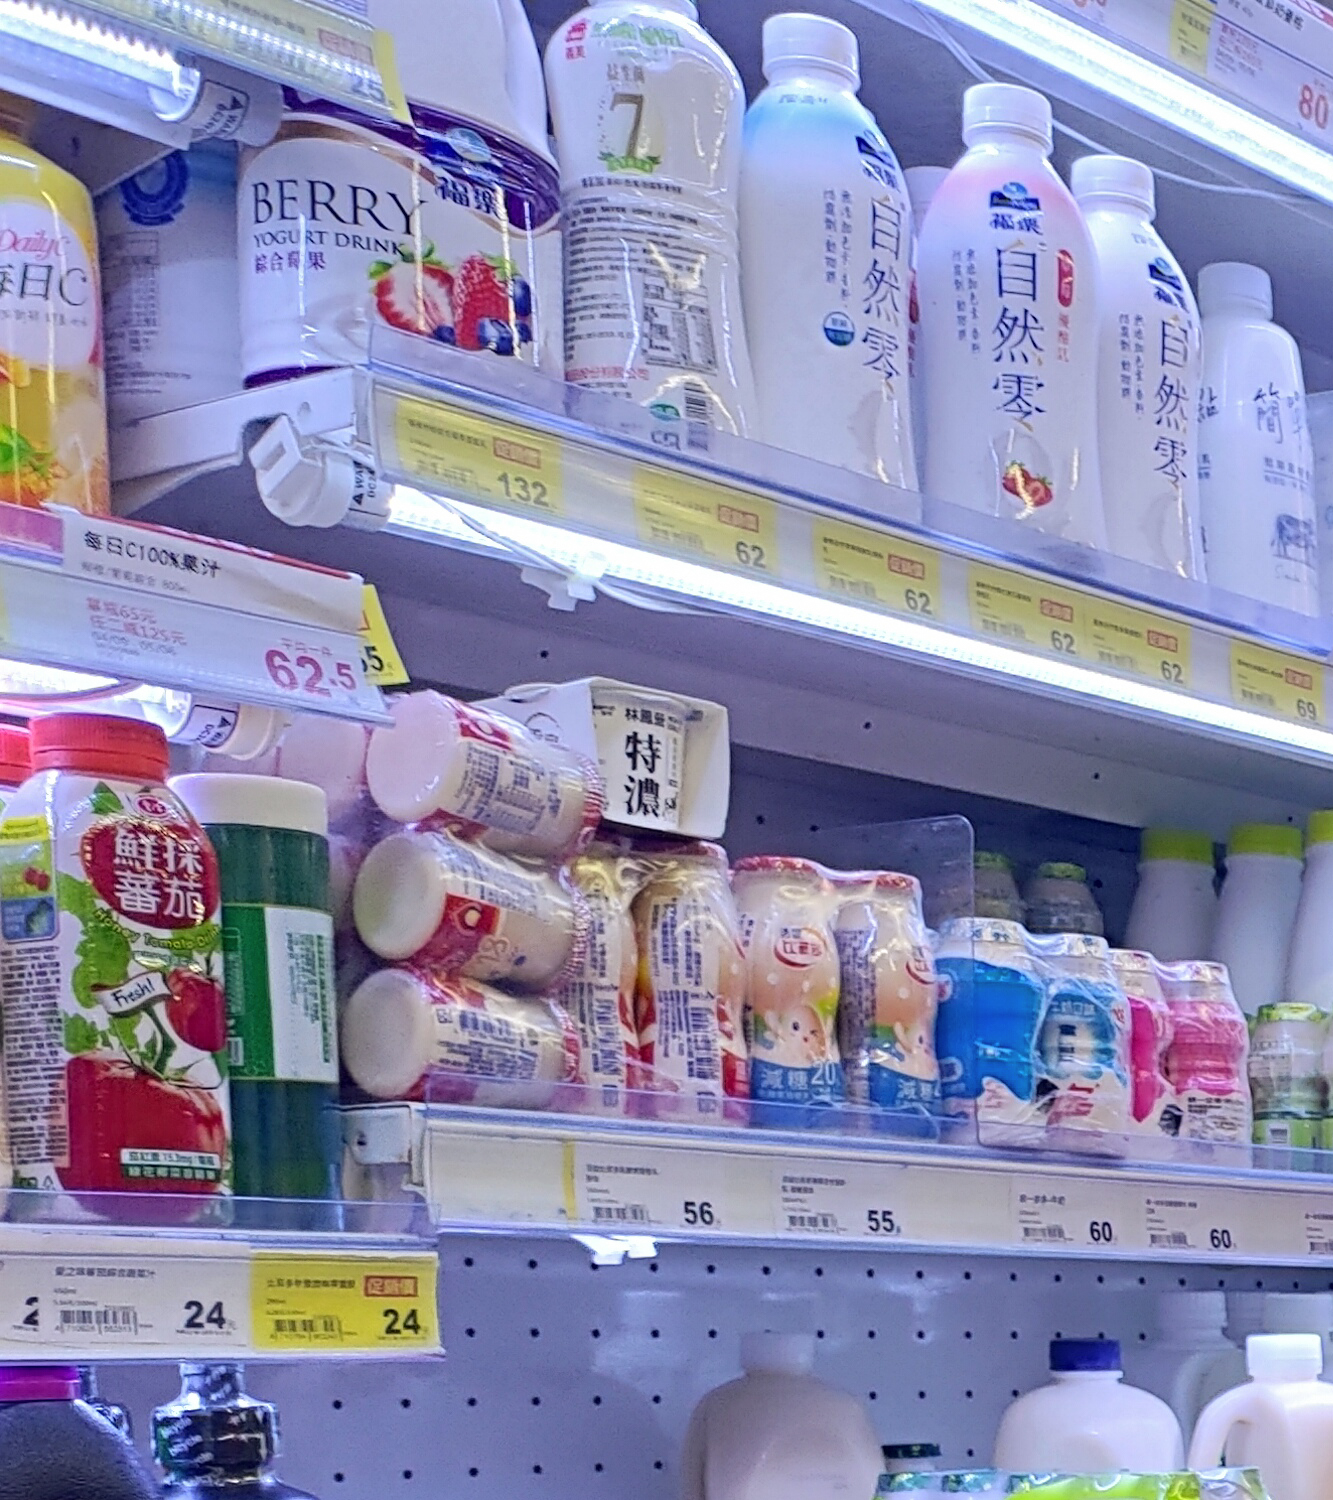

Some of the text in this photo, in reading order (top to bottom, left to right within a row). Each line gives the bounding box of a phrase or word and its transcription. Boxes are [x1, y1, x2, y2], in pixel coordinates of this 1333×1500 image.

[1299, 84, 1329, 130] 80
[609, 92, 644, 157] 7
[252, 178, 428, 237] BERRY
[253, 229, 407, 259] YOGURT DRINK
[992, 240, 1046, 424] 自然零
[1154, 314, 1189, 488] 自然零
[497, 471, 549, 506] 132
[735, 540, 766, 570] 62
[905, 587, 932, 614] 62
[1051, 630, 1076, 655] 62
[265, 649, 357, 697] 62.5
[1160, 660, 1184, 685] 62
[1296, 699, 1317, 721] 69
[625, 731, 661, 817] 特濃
[114, 832, 203, 873] 鮮採
[114, 872, 203, 920] 蕃茄
[113, 976, 156, 1008] Fresh!
[811, 1060, 837, 1086] 20
[683, 1201, 714, 1225] 56
[867, 1210, 895, 1233] 55
[1089, 1221, 1112, 1242] 60
[1210, 1229, 1231, 1249] 60
[184, 1300, 227, 1330] 24
[383, 1308, 421, 1336] 24
